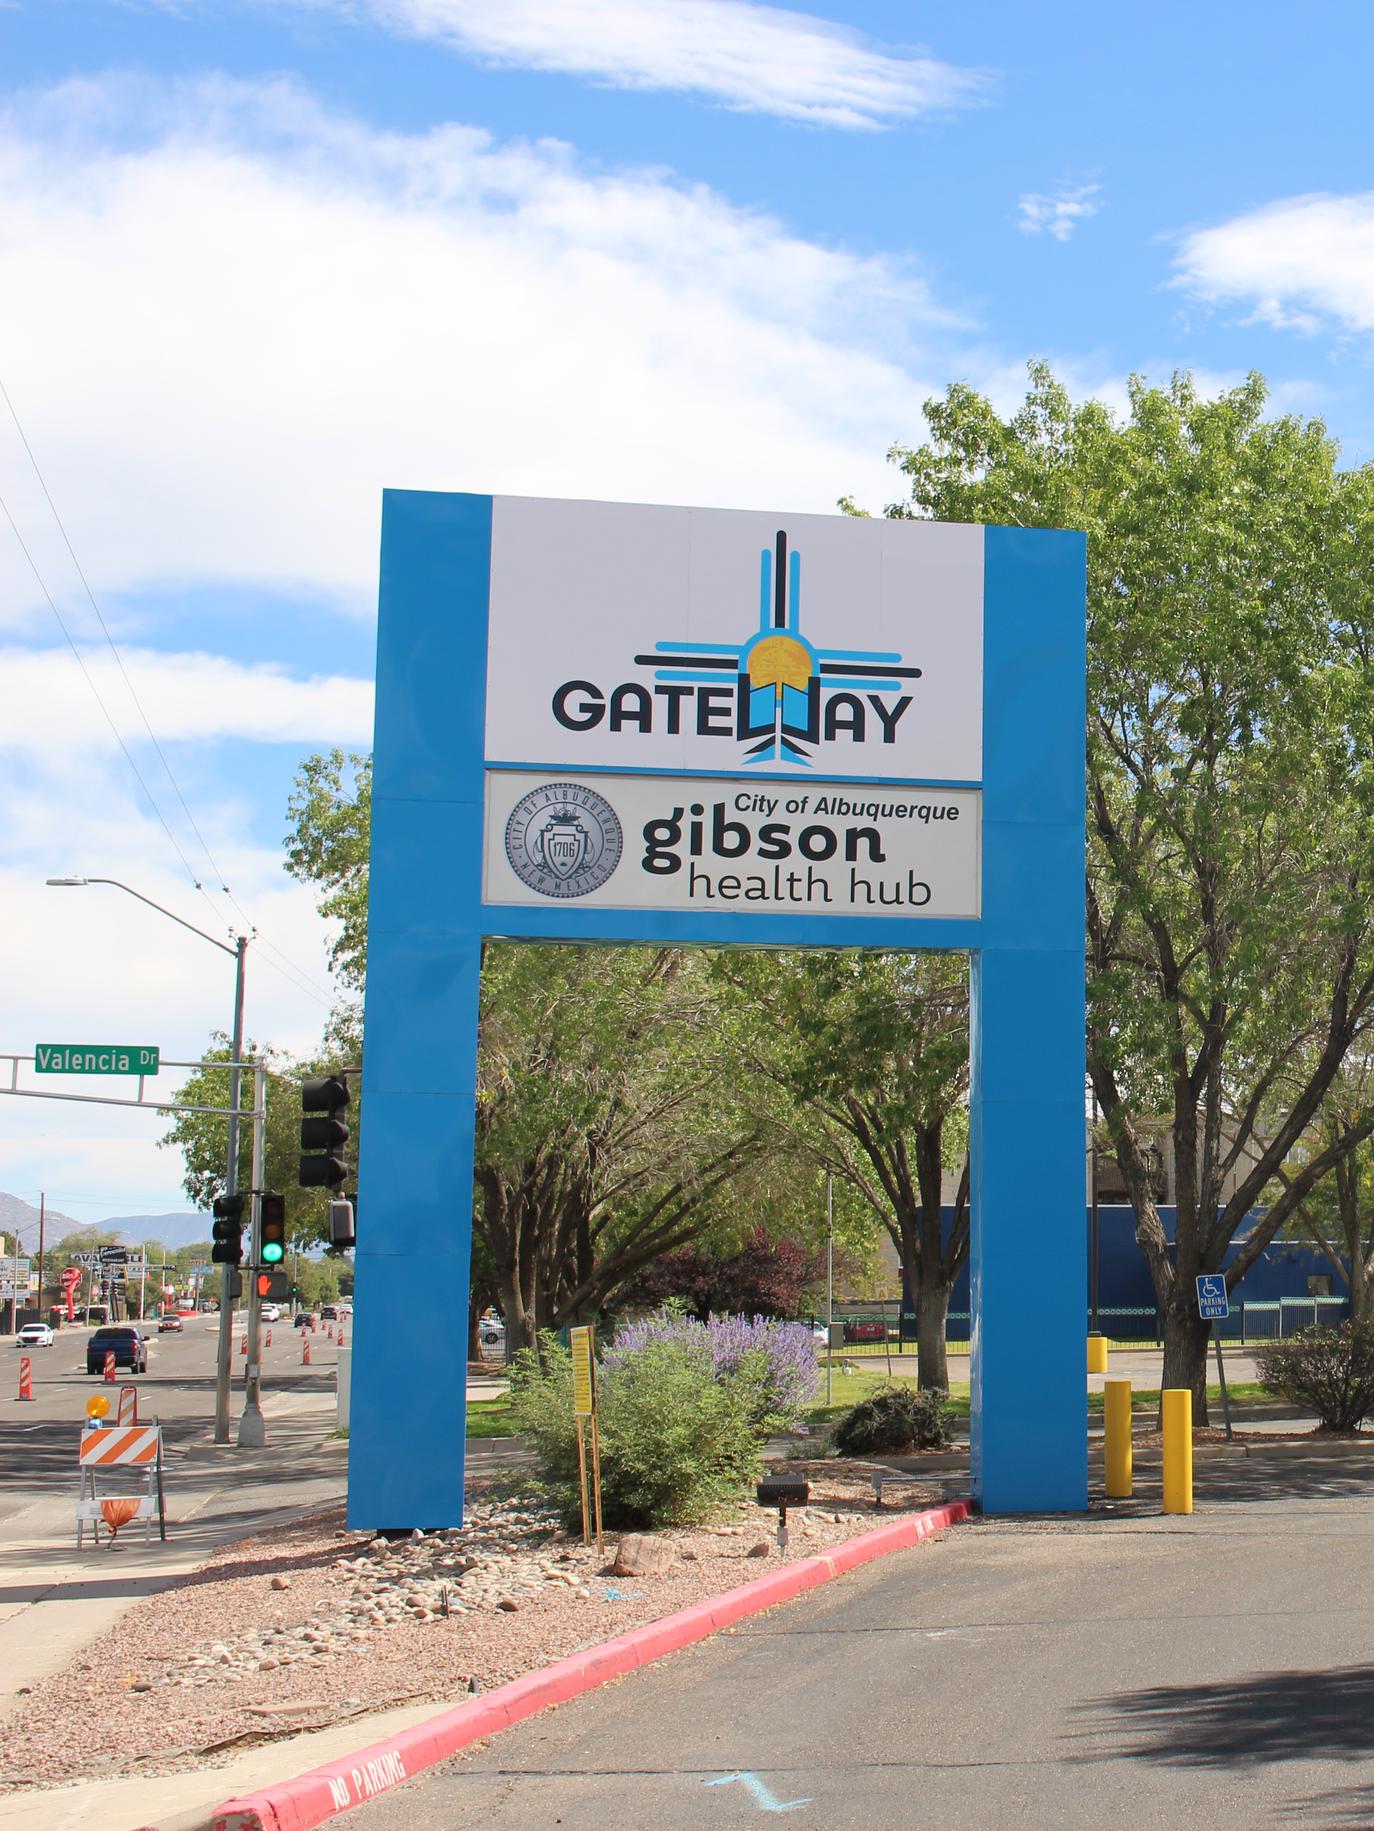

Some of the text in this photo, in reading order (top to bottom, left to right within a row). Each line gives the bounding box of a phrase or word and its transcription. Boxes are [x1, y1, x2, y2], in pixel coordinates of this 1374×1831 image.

[552, 673, 914, 745] GATEWAY
[512, 790, 616, 852] CITY OF ALBUQUERQUE
[734, 793, 960, 823] City of Albuquerque
[554, 842, 575, 858] 1706
[641, 802, 887, 875] gibson
[521, 864, 608, 891] NEW MEXICO
[689, 861, 932, 906] health hub
[38, 1048, 157, 1071] Valencia Dr
[1201, 1297, 1225, 1306] PARKING
[1206, 1306, 1222, 1316] ONLY
[329, 1750, 406, 1812] NO PARKING
